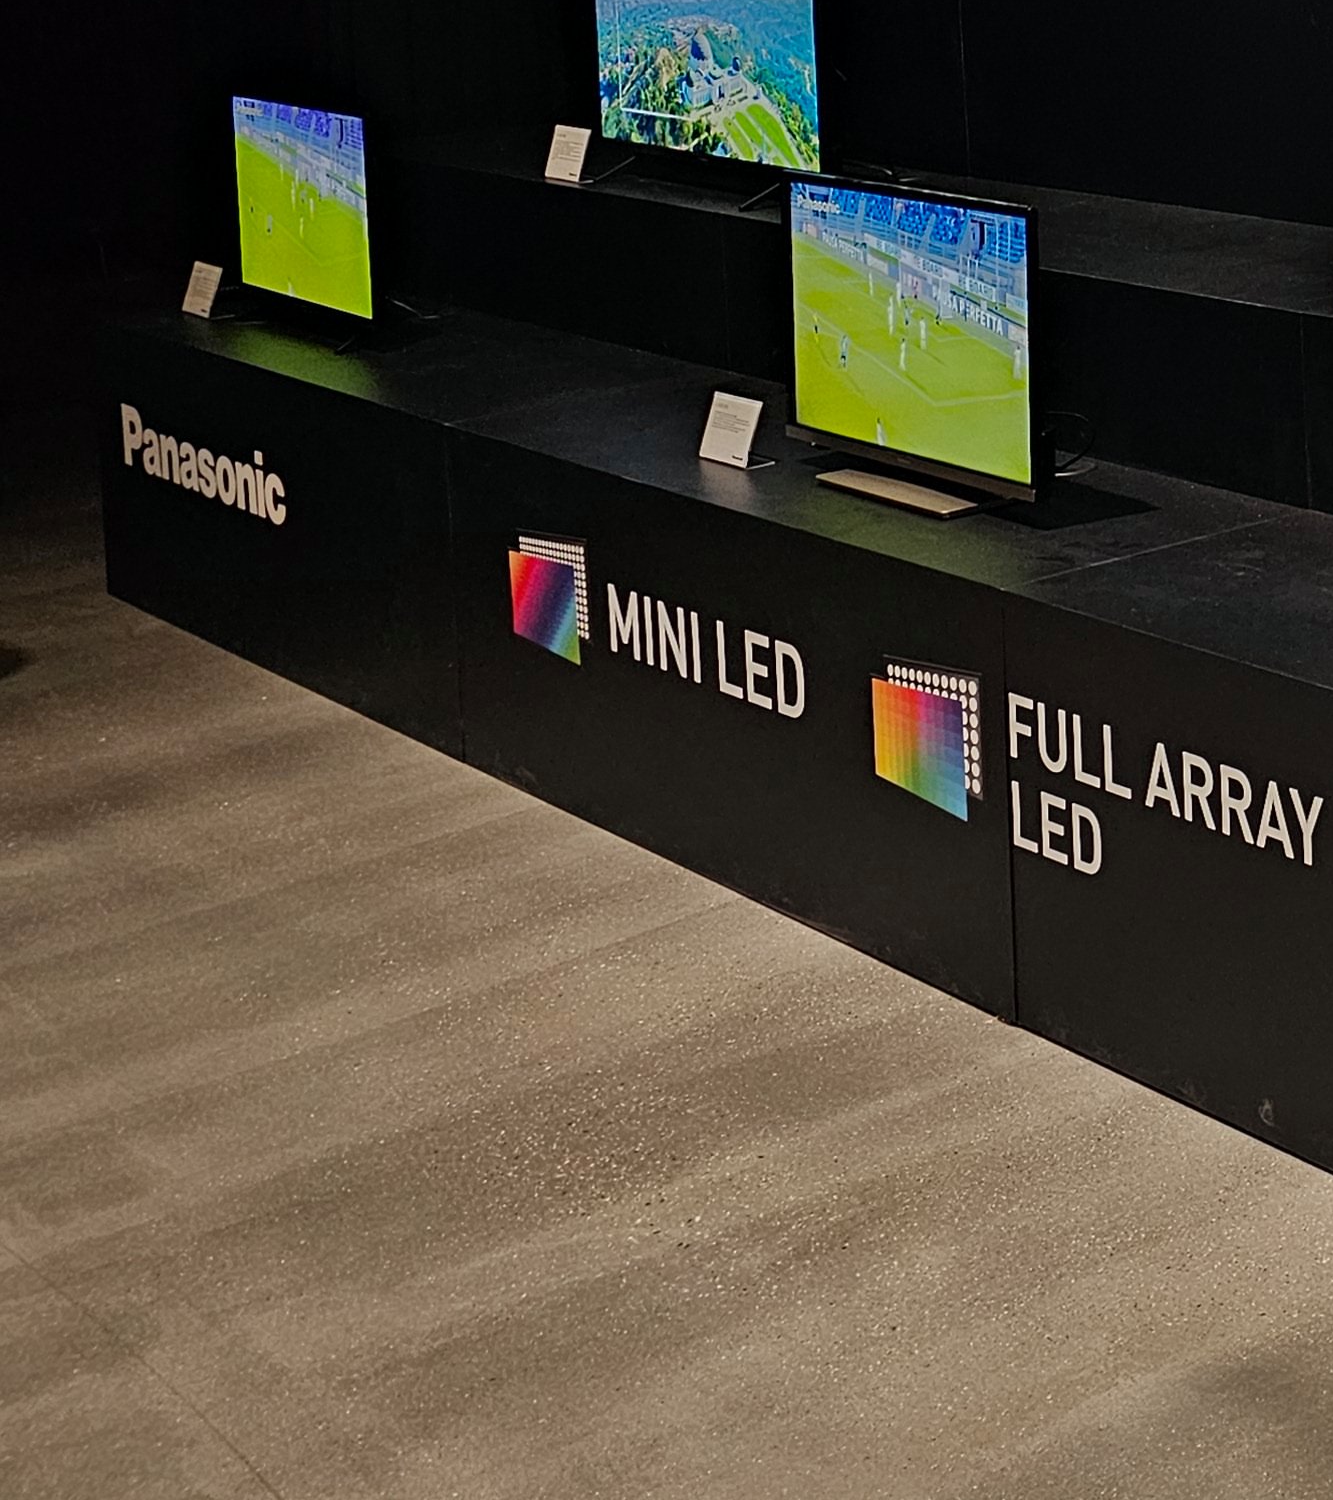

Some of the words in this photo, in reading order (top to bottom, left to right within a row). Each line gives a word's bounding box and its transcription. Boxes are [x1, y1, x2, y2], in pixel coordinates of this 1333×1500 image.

[120, 402, 287, 526] Panasonic
[607, 583, 701, 684] MINI
[716, 620, 805, 719] LED
[1008, 692, 1132, 800] FULL
[1145, 742, 1324, 866] ARRAY
[1011, 780, 1102, 875] LED
